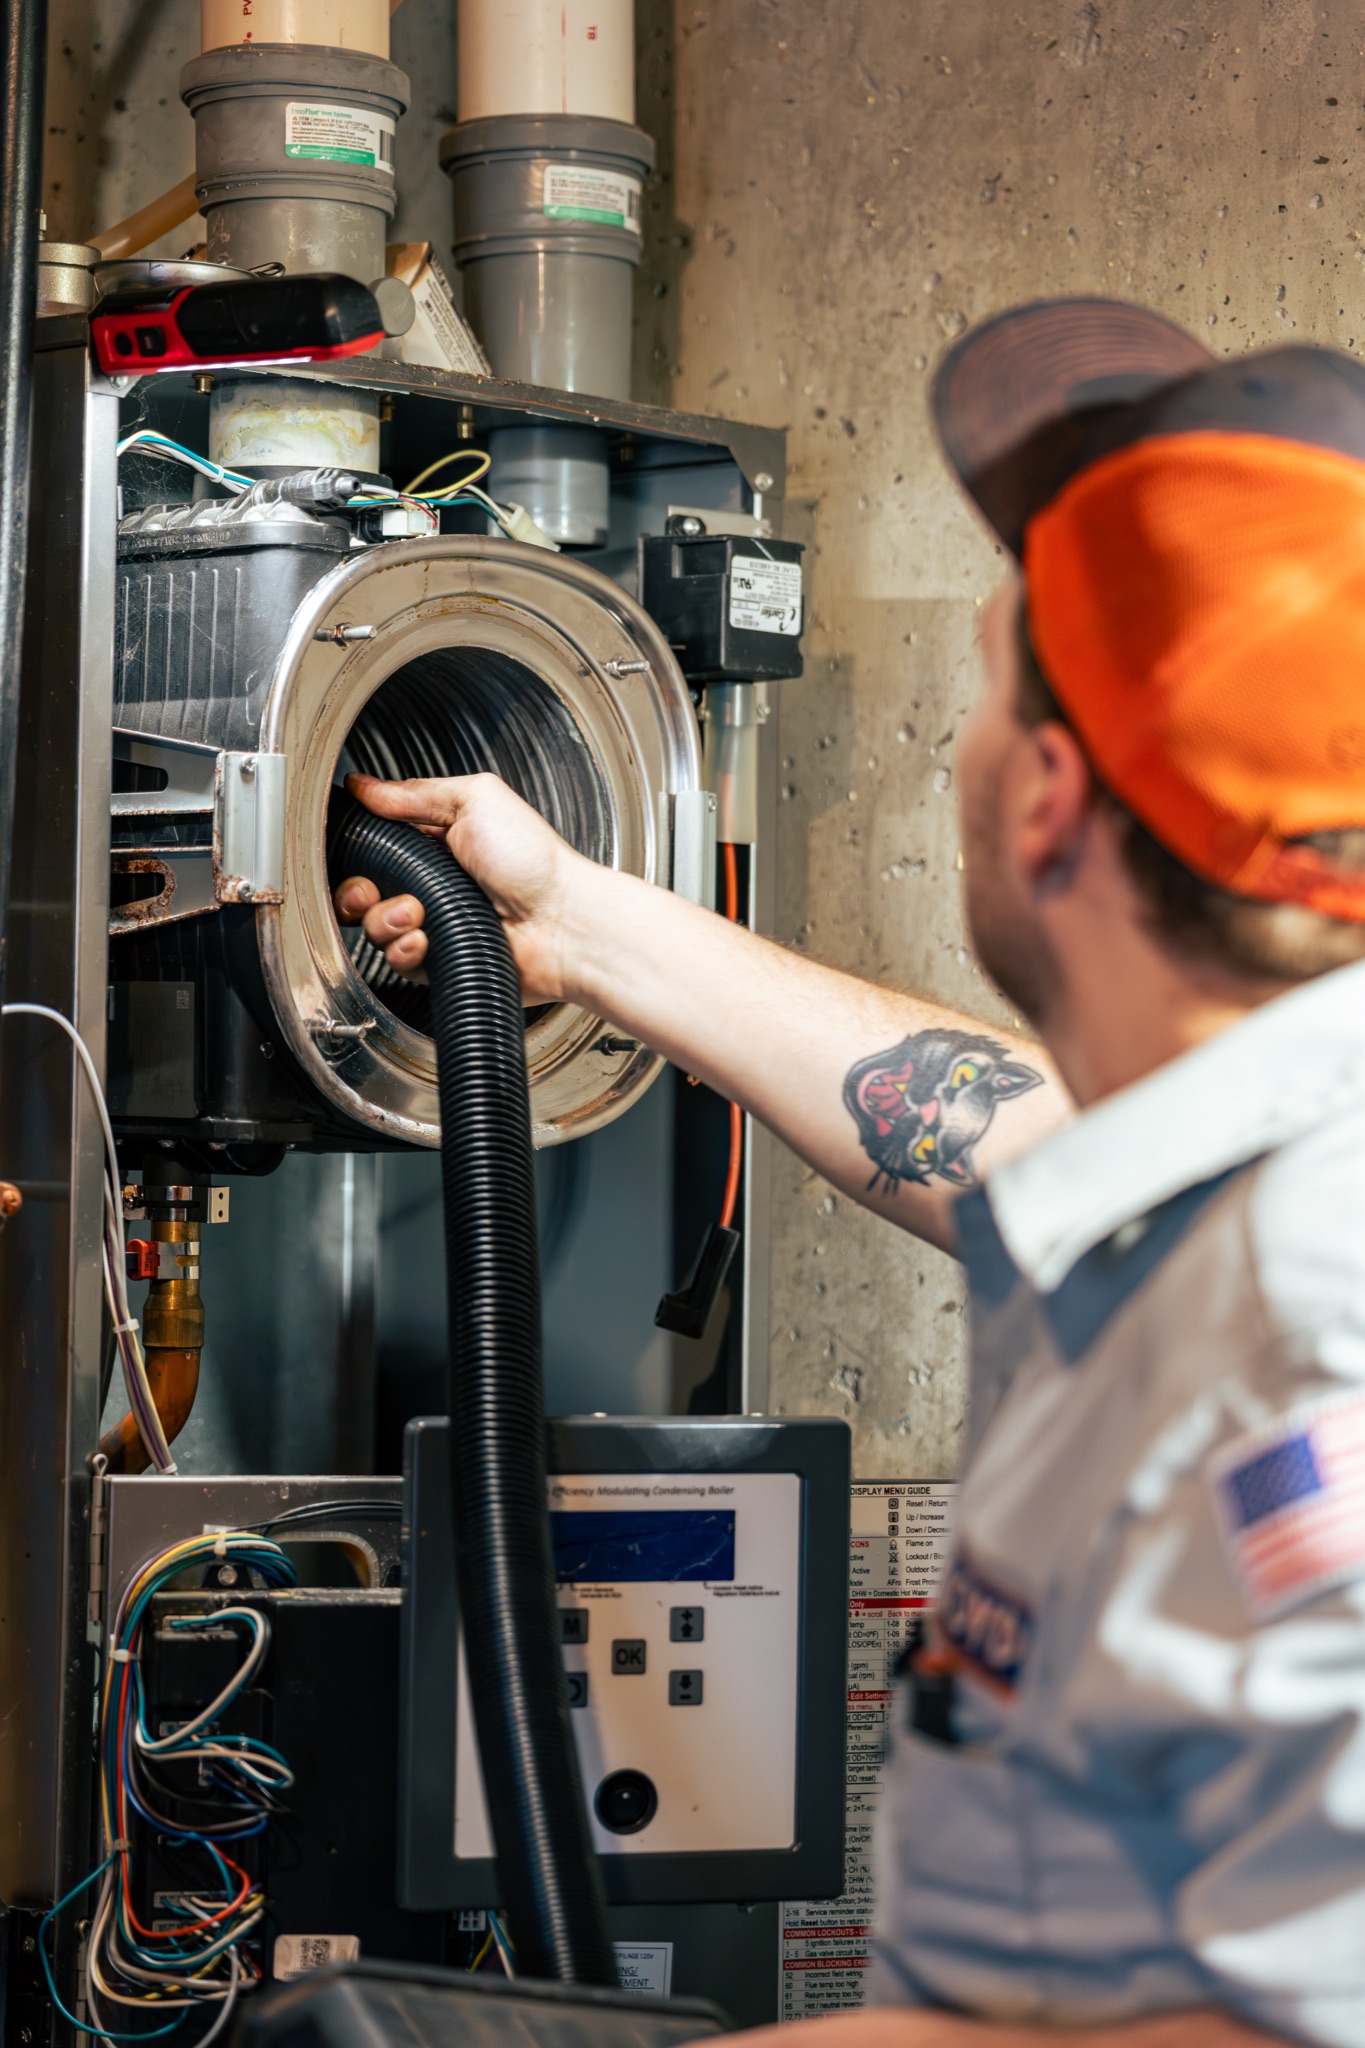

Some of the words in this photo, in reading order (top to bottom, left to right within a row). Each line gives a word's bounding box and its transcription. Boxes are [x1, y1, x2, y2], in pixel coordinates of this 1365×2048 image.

[761, 608, 785, 620] Carlin
[597, 1486, 649, 1496] Modulating
[652, 1486, 705, 1496] Condensing
[708, 1486, 734, 1495] Boiler
[850, 1487, 882, 1495] DISPLAY
[884, 1487, 905, 1495] MENU
[907, 1486, 931, 1495] GUIDE
[906, 1514, 915, 1522] Up
[906, 1526, 923, 1534] Down
[615, 1647, 643, 1666] OK
[851, 1661, 868, 1671] (gpm)
[859, 1672, 875, 1680] (rpm)
[851, 1692, 864, 1700] Edit
[848, 1765, 865, 1773] target
[849, 1876, 864, 1884] DHW
[785, 1909, 799, 1917] 2-16
[785, 1930, 816, 1938] COMMON
[817, 1929, 854, 1937] LOCKOUTS
[810, 1939, 832, 1948] ignition
[819, 1949, 834, 1957] valve
[785, 1961, 816, 1969] COMMON
[817, 1960, 852, 1968] BLOCKING
[846, 1970, 863, 1978] wiring
[819, 1981, 834, 1989] temp
[846, 1980, 858, 1989] high
[805, 1991, 824, 1999] Return
[826, 1991, 840, 1999] temp
